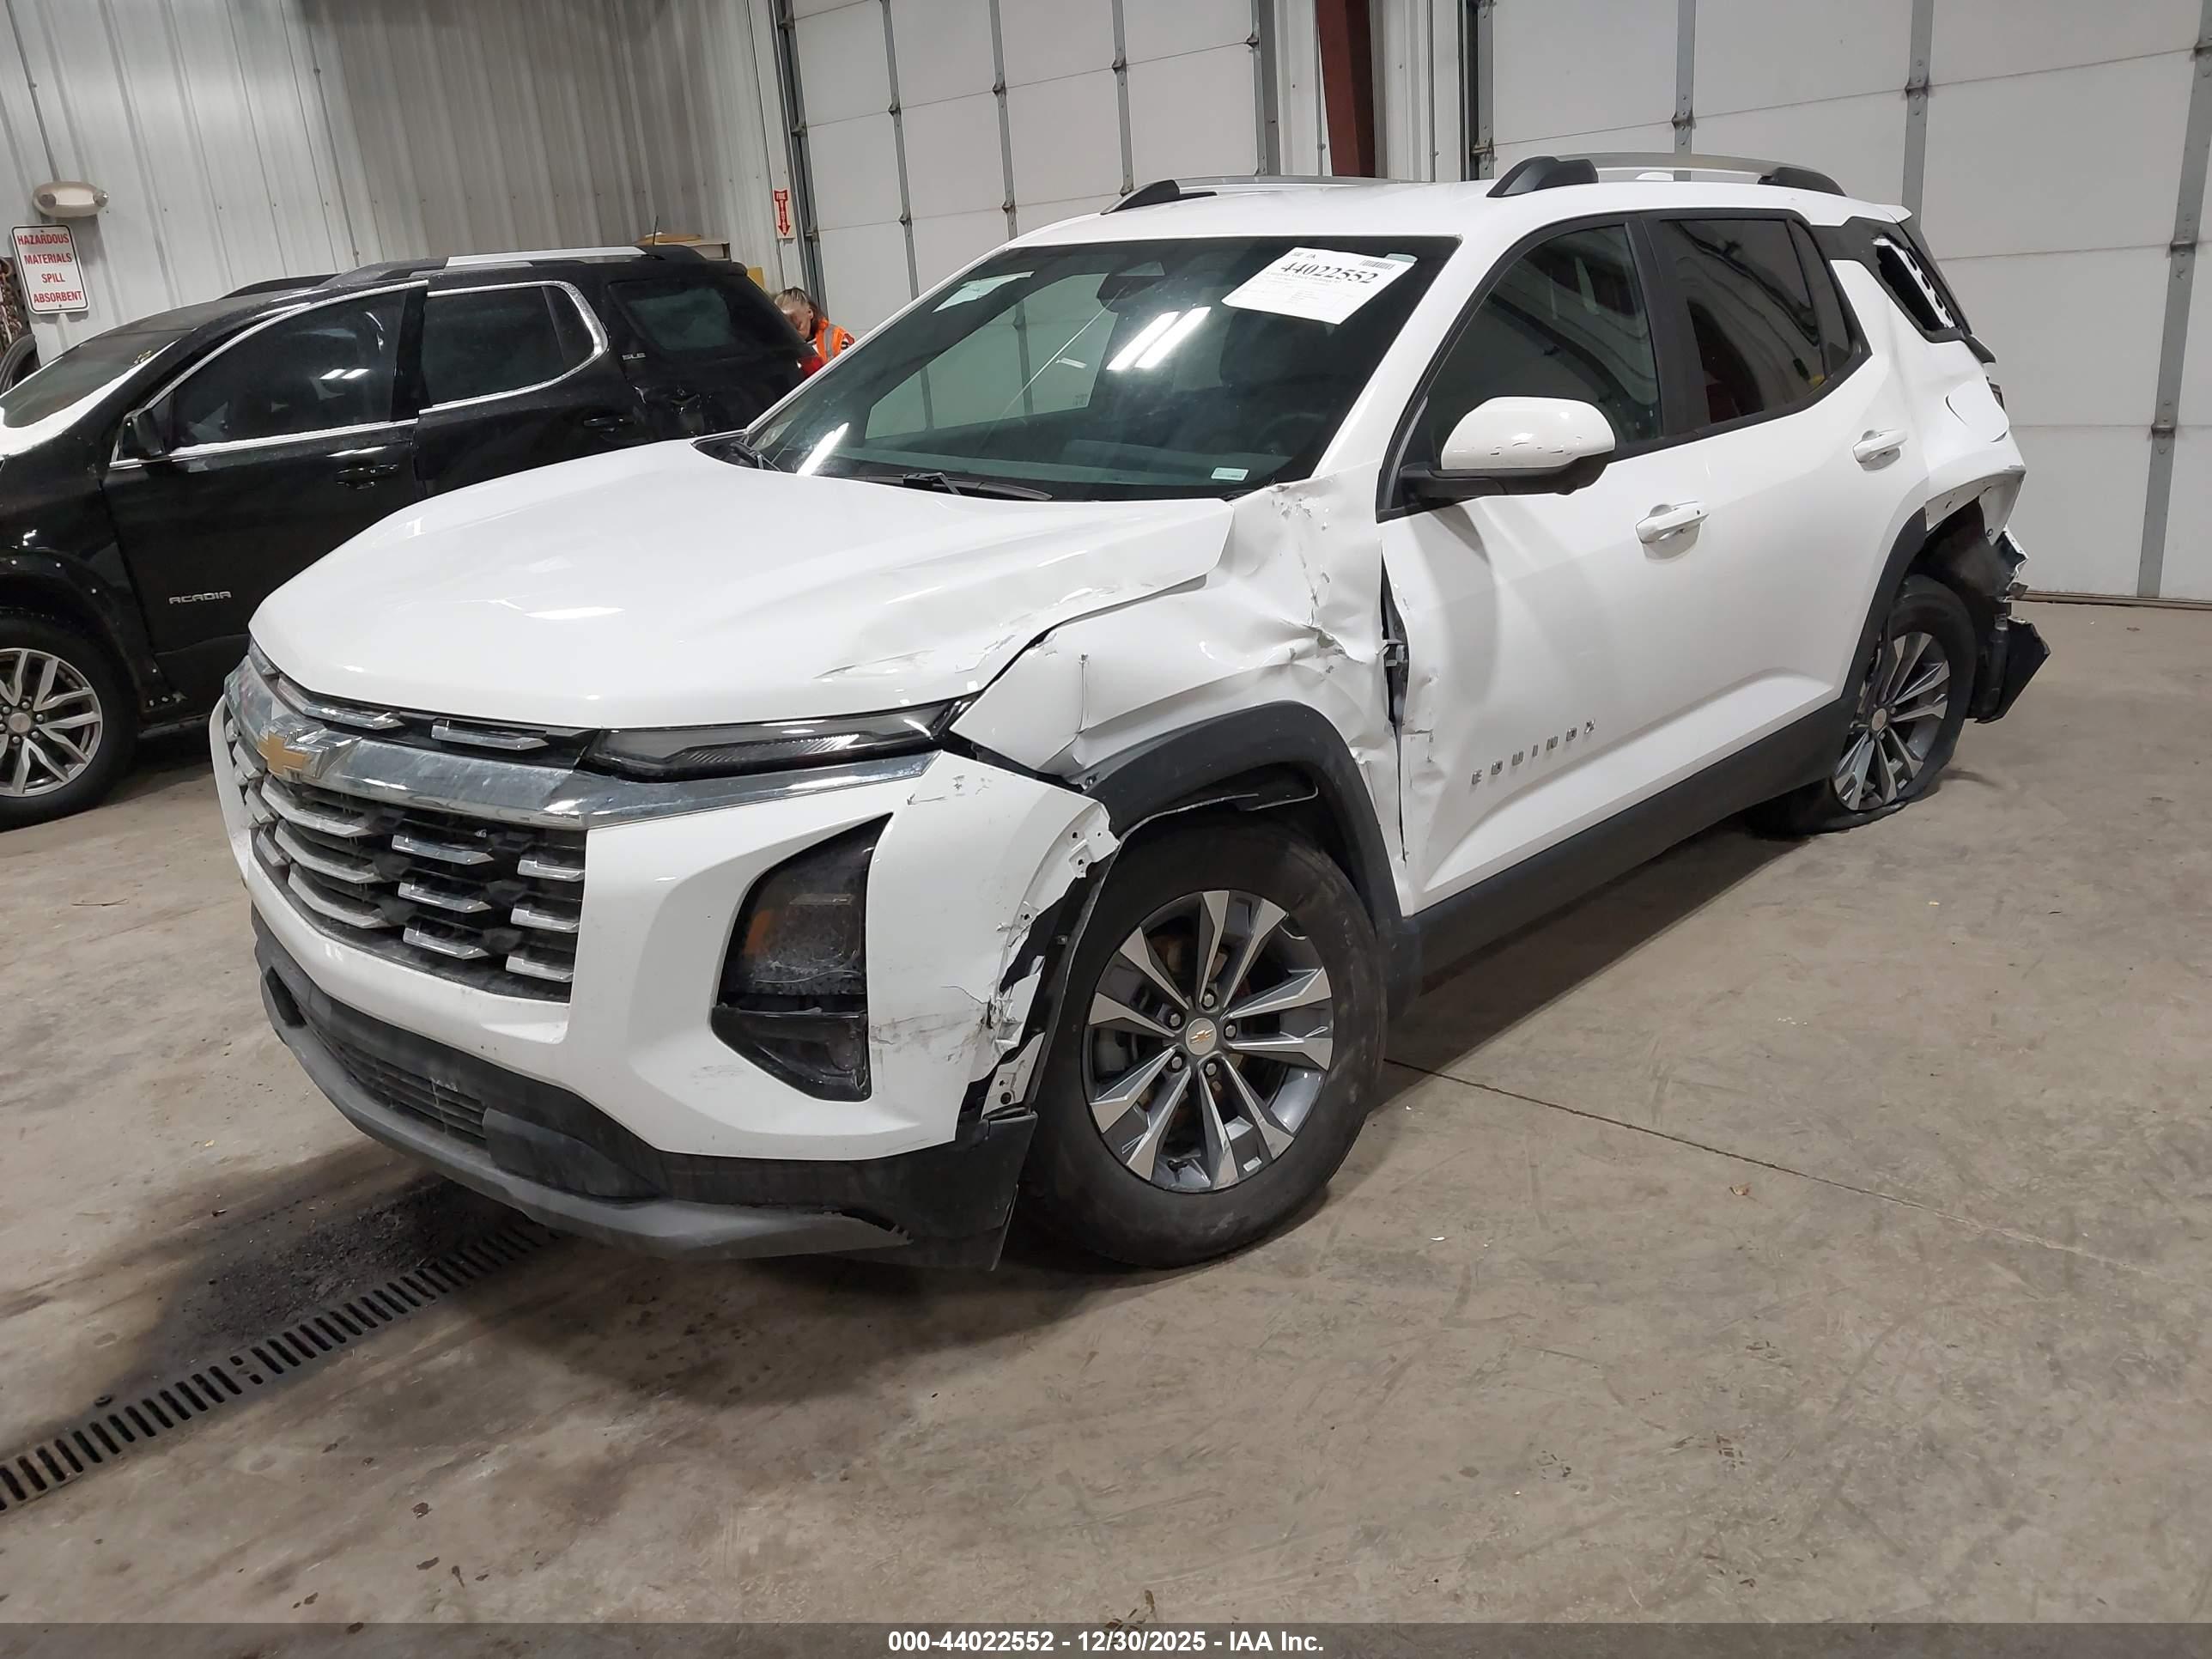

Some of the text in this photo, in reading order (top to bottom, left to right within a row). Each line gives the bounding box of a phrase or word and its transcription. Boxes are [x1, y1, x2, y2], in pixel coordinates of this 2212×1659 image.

[17, 234, 69, 245] HAZARDOUS
[24, 253, 72, 264] MATERIALS
[41, 273, 65, 283] SPILL
[1280, 262, 1378, 283] 44022552
[33, 291, 82, 303] ABSORBENT
[622, 352, 646, 361] SLE
[168, 591, 232, 604] ACADIA
[1471, 718, 1595, 785] EQUINOX
